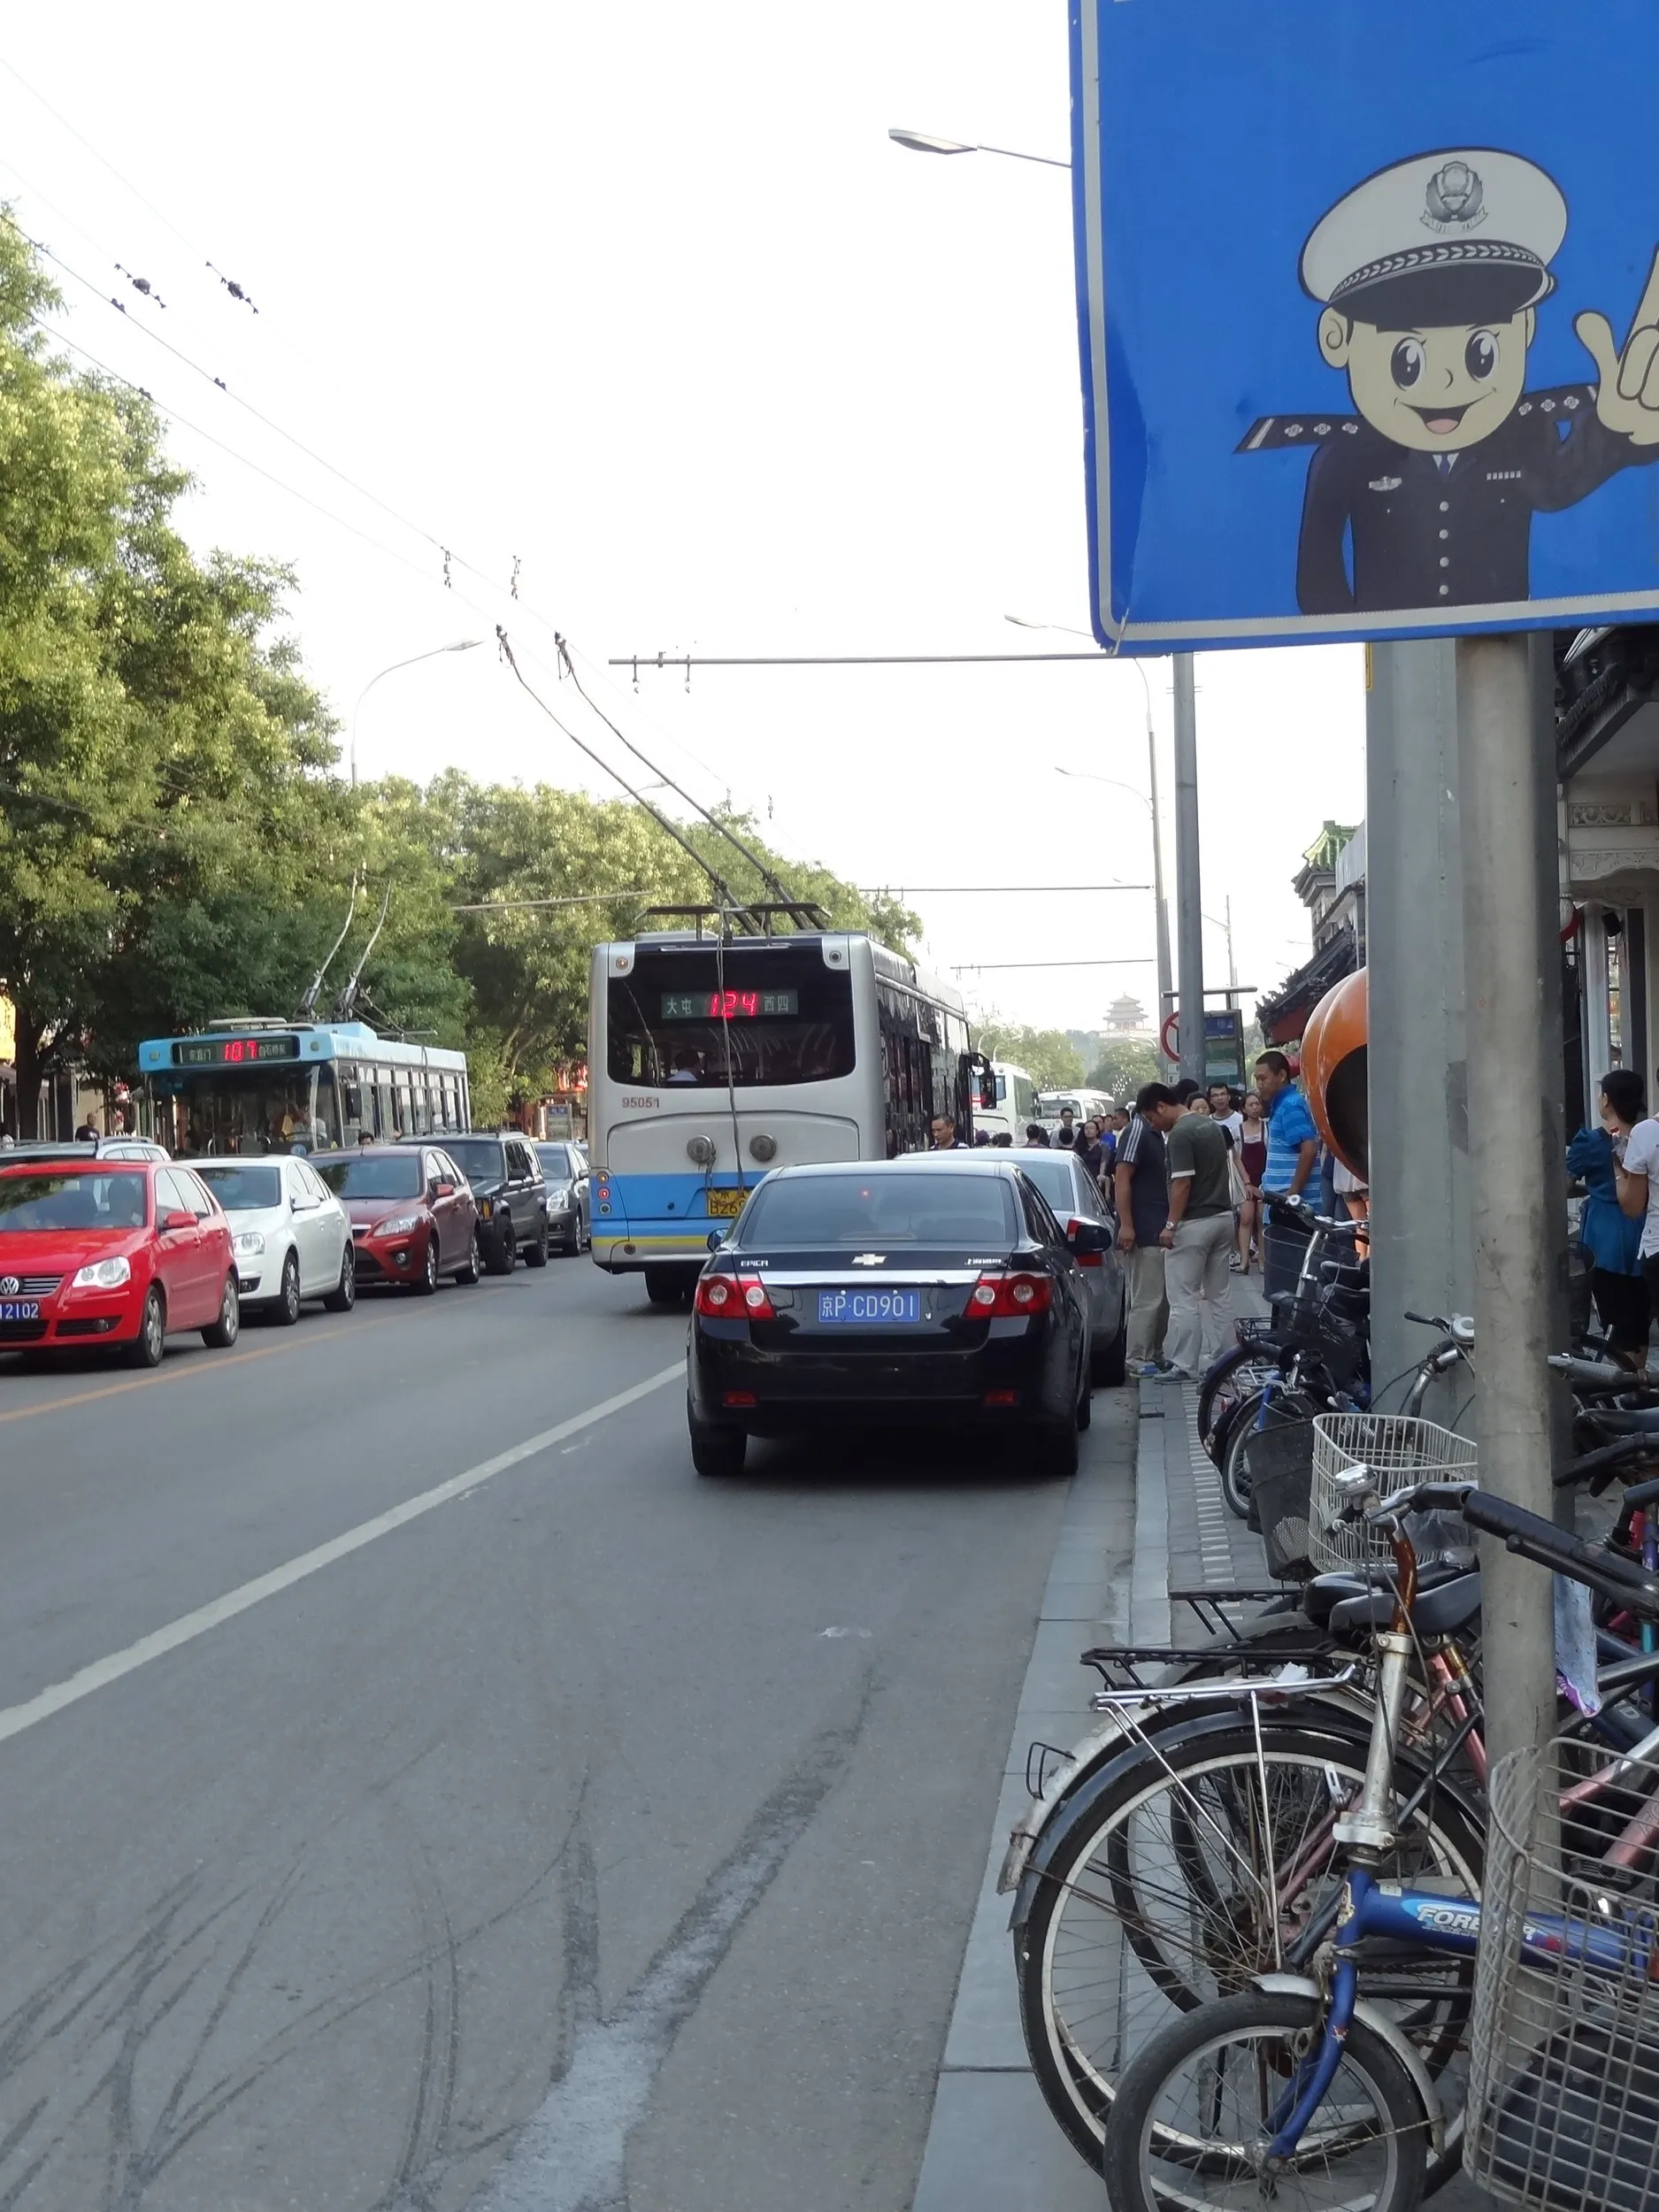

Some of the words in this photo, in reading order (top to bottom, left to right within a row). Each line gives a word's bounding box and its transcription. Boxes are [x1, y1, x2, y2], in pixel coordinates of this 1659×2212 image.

[667, 998, 692, 1015] 大屯
[710, 992, 757, 1018] 124
[764, 995, 789, 1012] 西四
[225, 1041, 257, 1061] 107
